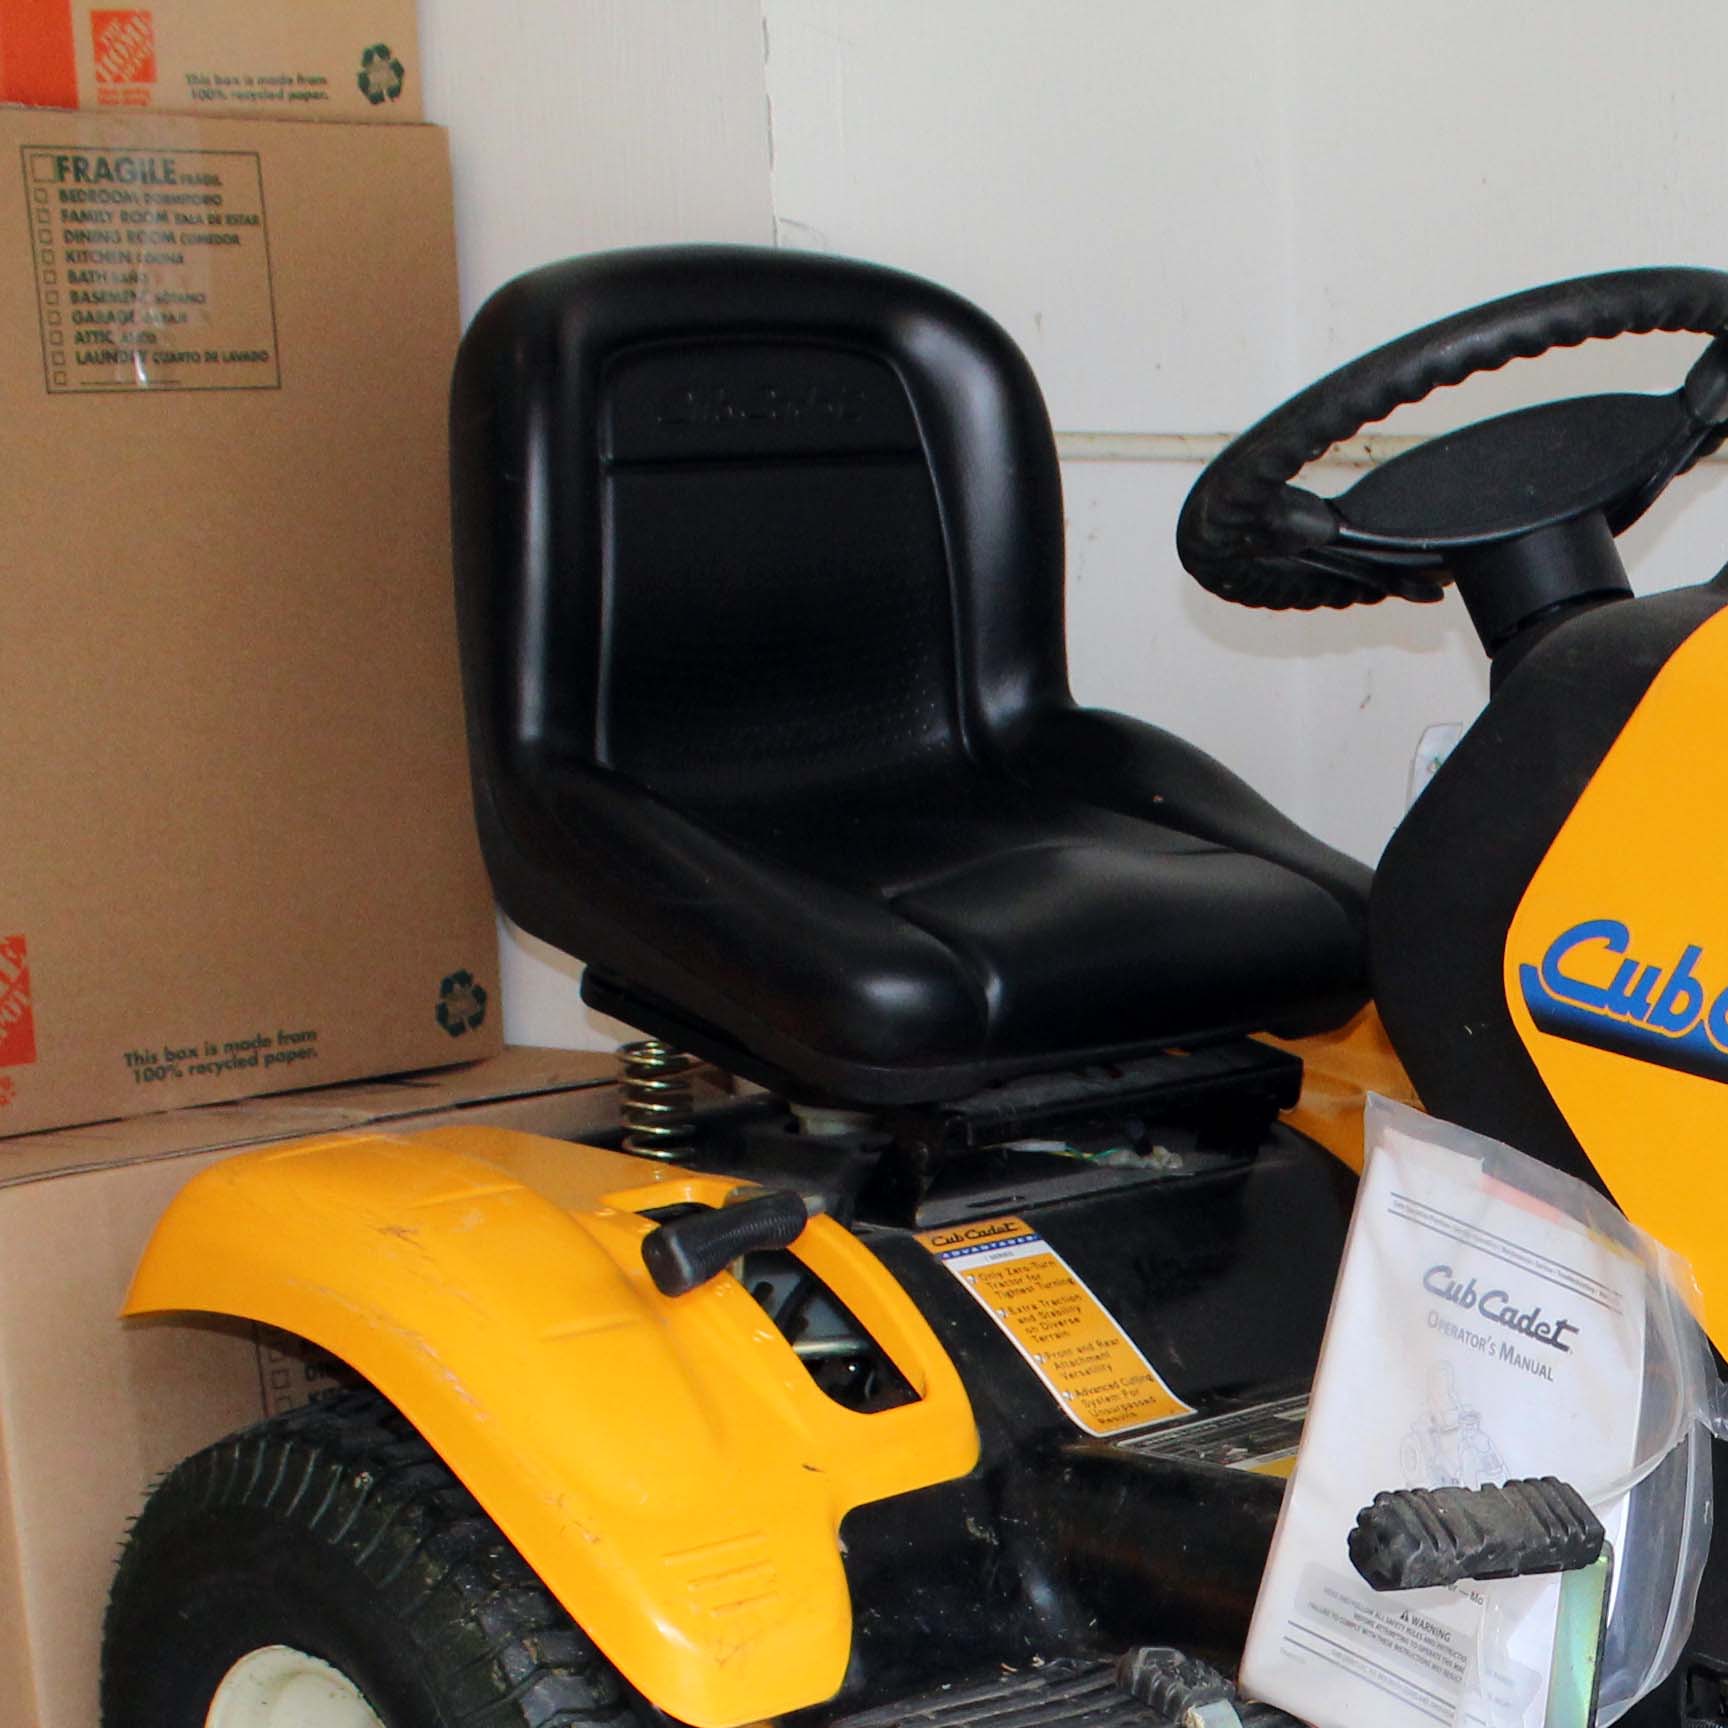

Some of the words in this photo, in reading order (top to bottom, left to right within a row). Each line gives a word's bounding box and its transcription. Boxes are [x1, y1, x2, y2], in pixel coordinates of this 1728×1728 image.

[257, 73, 293, 85] made
[297, 73, 327, 85] from
[55, 155, 176, 185] FRAGILE
[59, 189, 138, 204] BEDROOM
[60, 209, 112, 223] FAMILY
[120, 210, 169, 224] ROOM
[208, 213, 222, 224] DE
[64, 229, 121, 244] DINING
[126, 230, 175, 244] ROOM
[65, 250, 131, 263] KITCHEN
[1541, 919, 1703, 1032] Cub
[124, 1051, 157, 1067] This
[164, 1046, 198, 1062] box
[204, 1042, 217, 1056] is
[223, 1033, 272, 1054] made
[277, 1030, 317, 1045] from
[133, 1065, 183, 1084] 100%
[188, 1051, 258, 1077] recycled
[264, 1046, 318, 1067] paper.
[931, 1233, 963, 1247] Cub
[964, 1222, 1018, 1240] Cadet
[1423, 1265, 1477, 1309] Cub
[1478, 1290, 1580, 1352] Cadet
[1499, 1341, 1554, 1382] MANUAL
[1411, 1616, 1451, 1642] WARNING
